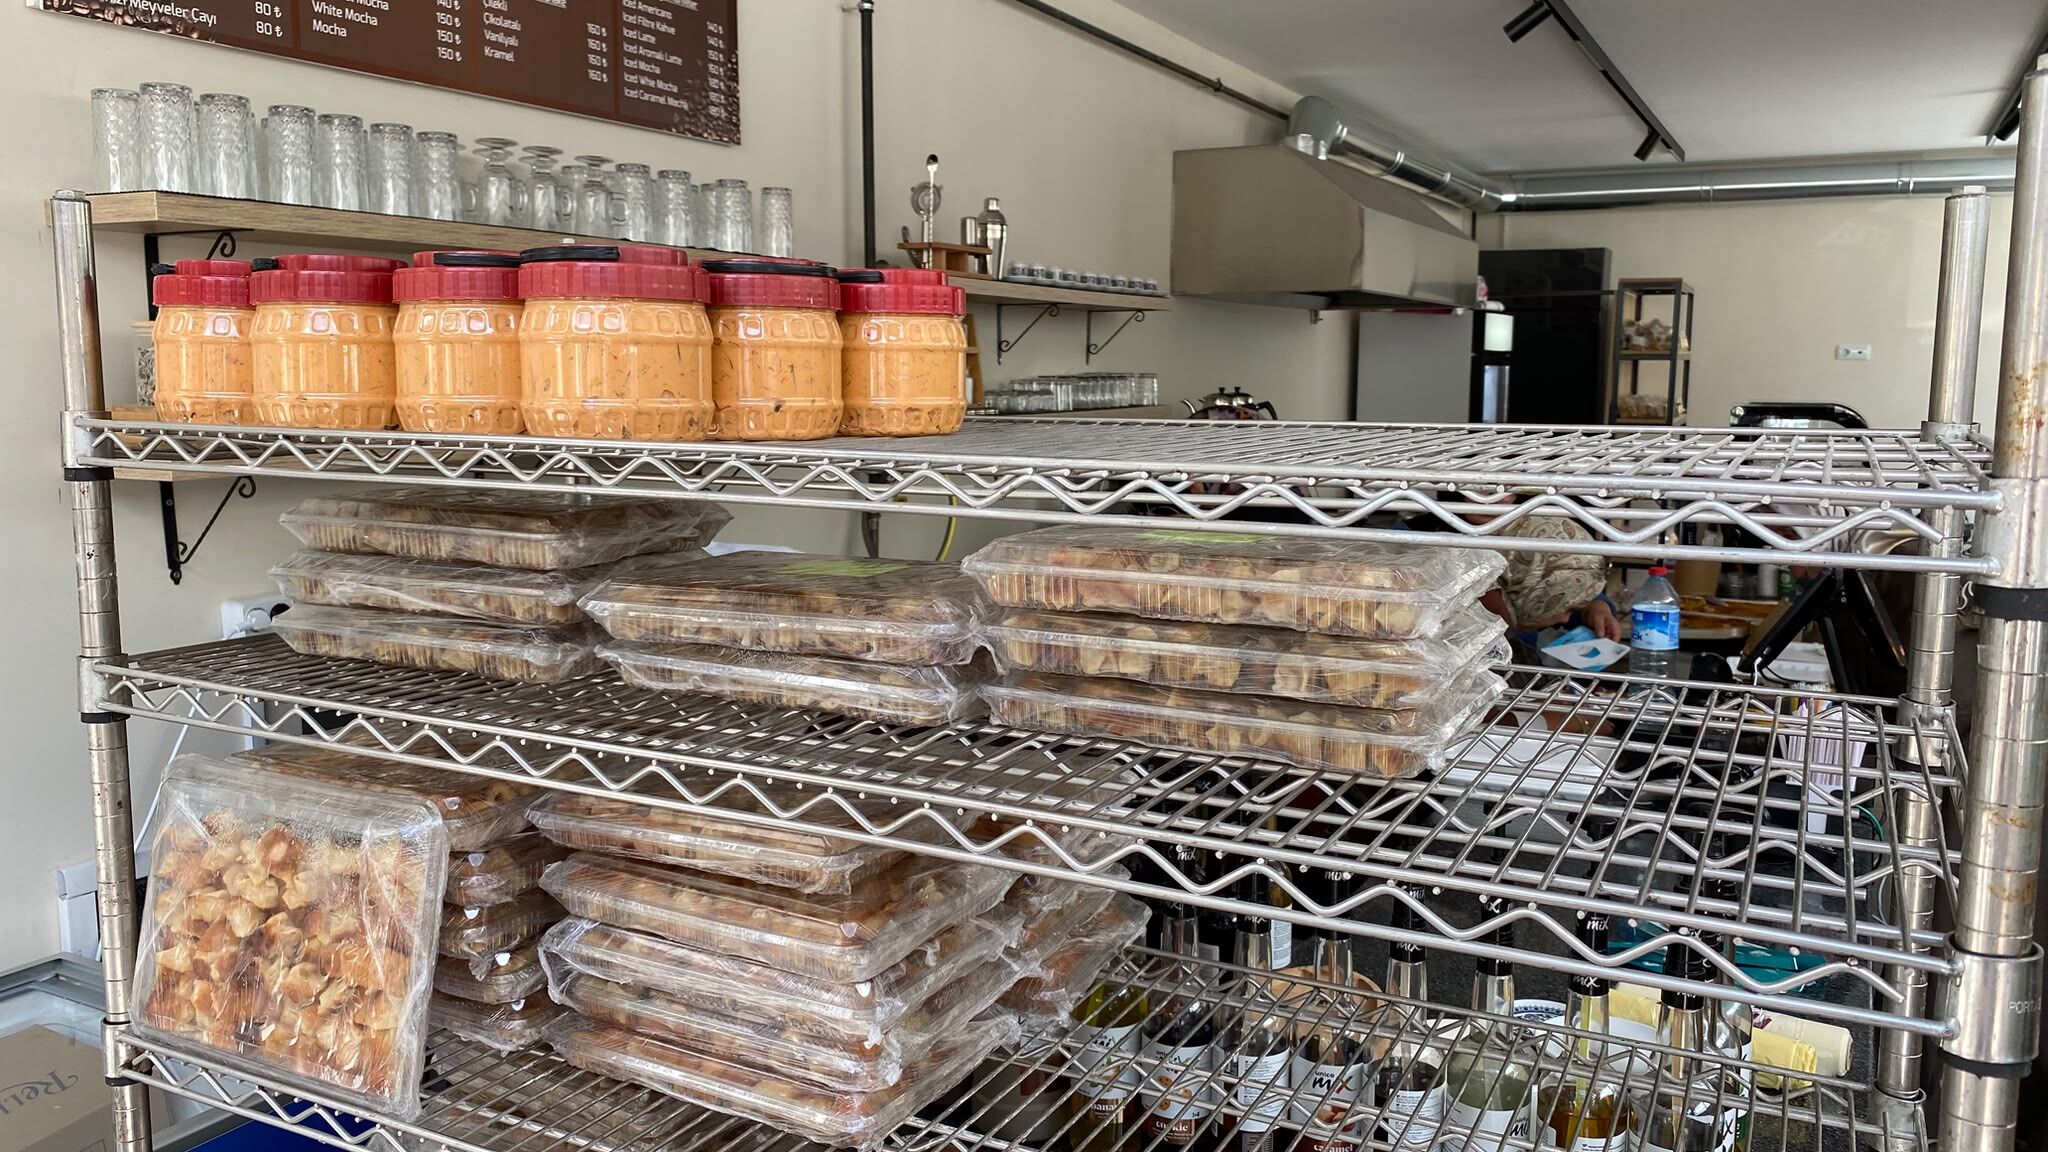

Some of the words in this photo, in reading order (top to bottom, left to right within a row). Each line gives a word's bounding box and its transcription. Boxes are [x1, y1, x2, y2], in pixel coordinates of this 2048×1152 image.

[130, 0, 189, 18] Meyveler
[191, 7, 217, 27] Çayı
[254, 1, 272, 16] 80
[311, 0, 343, 18] White
[344, 7, 378, 26] Mocha
[435, 12, 453, 26] 150
[622, 11, 637, 24] Iced
[255, 21, 273, 36] 80
[312, 19, 347, 37] Mocha
[622, 26, 637, 39] Iced
[436, 29, 454, 43] 150
[436, 46, 454, 60] 150
[484, 46, 515, 62] Kramel
[623, 41, 638, 54] Iced
[623, 56, 638, 69] Iced
[638, 60, 661, 74] Mocha
[623, 71, 639, 84] Iced
[656, 79, 679, 93] Mocha
[624, 87, 639, 99] Iced
[667, 96, 689, 111] Mocha
[1586, 914, 1609, 931] mix
[1315, 1070, 1335, 1079] unico
